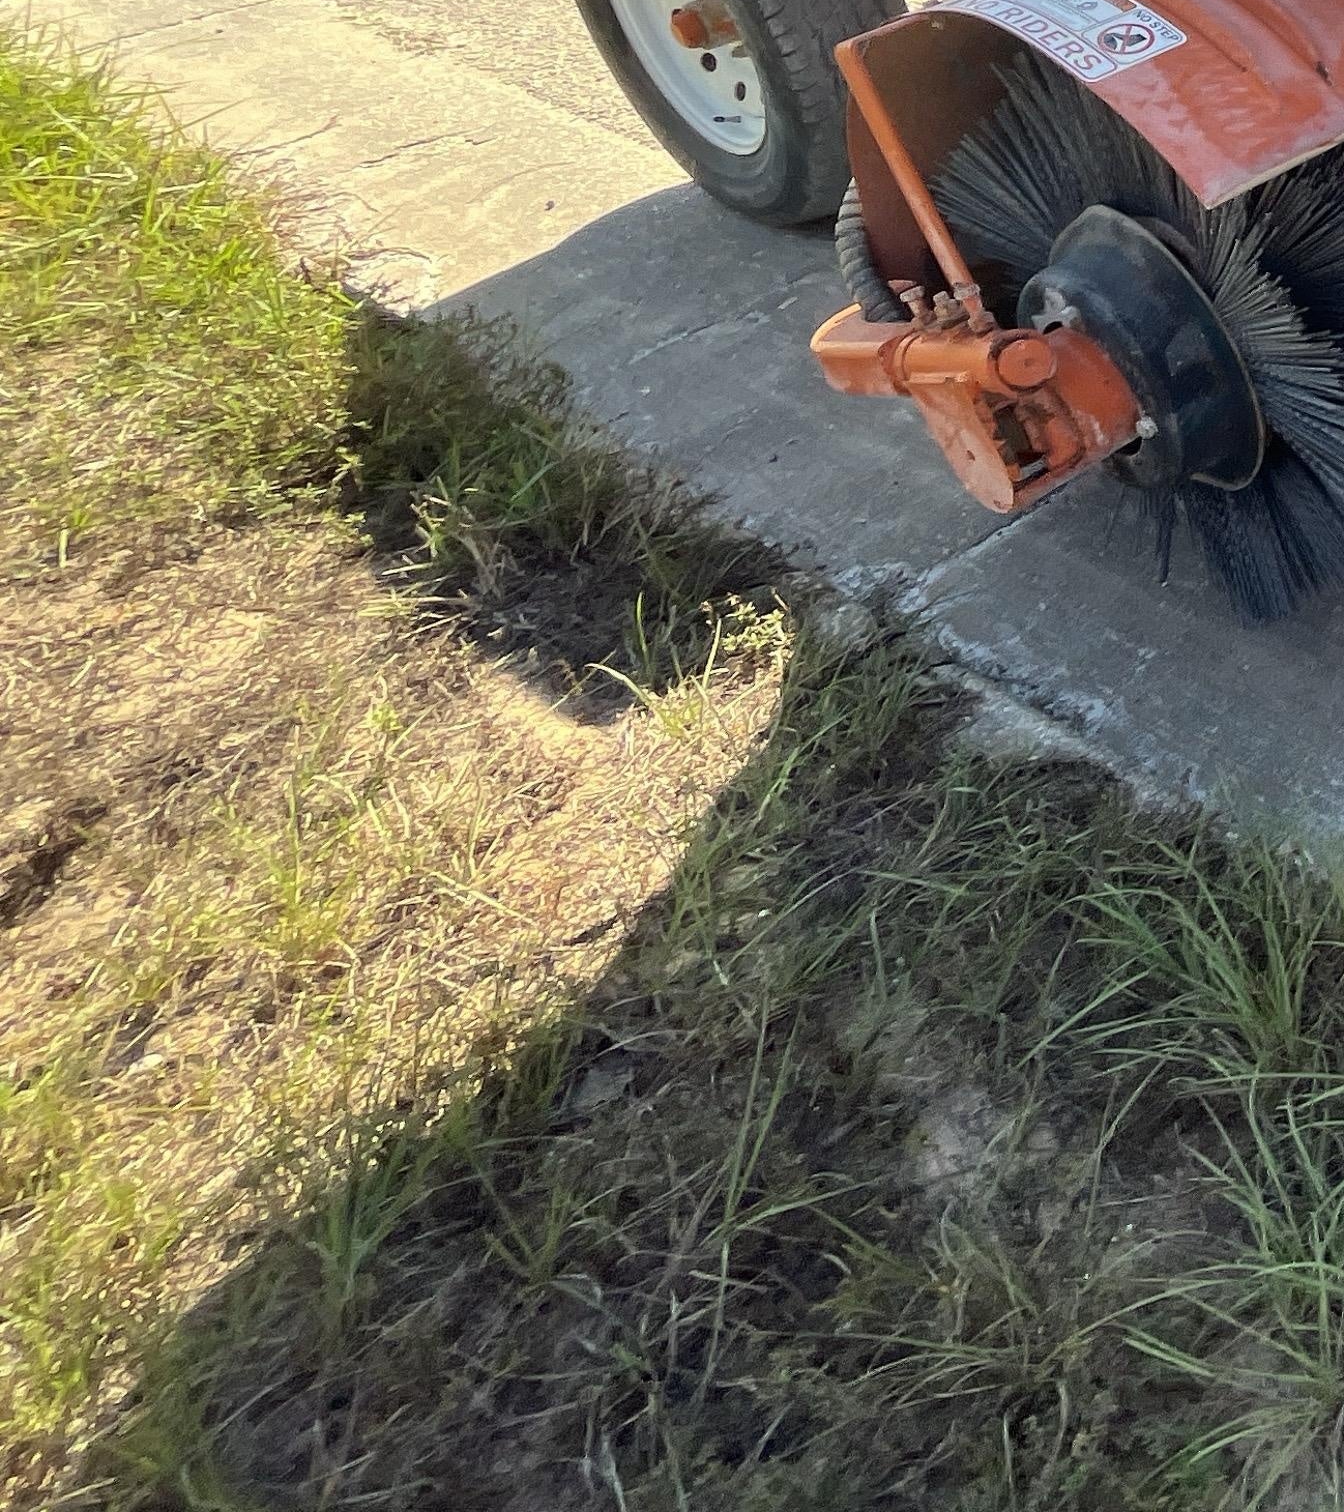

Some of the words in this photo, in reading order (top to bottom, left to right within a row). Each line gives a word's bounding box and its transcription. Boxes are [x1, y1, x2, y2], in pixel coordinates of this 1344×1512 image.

[995, 7, 1103, 71] RIDERS
[1134, 9, 1151, 23] NO
[1149, 20, 1180, 41] STEP
